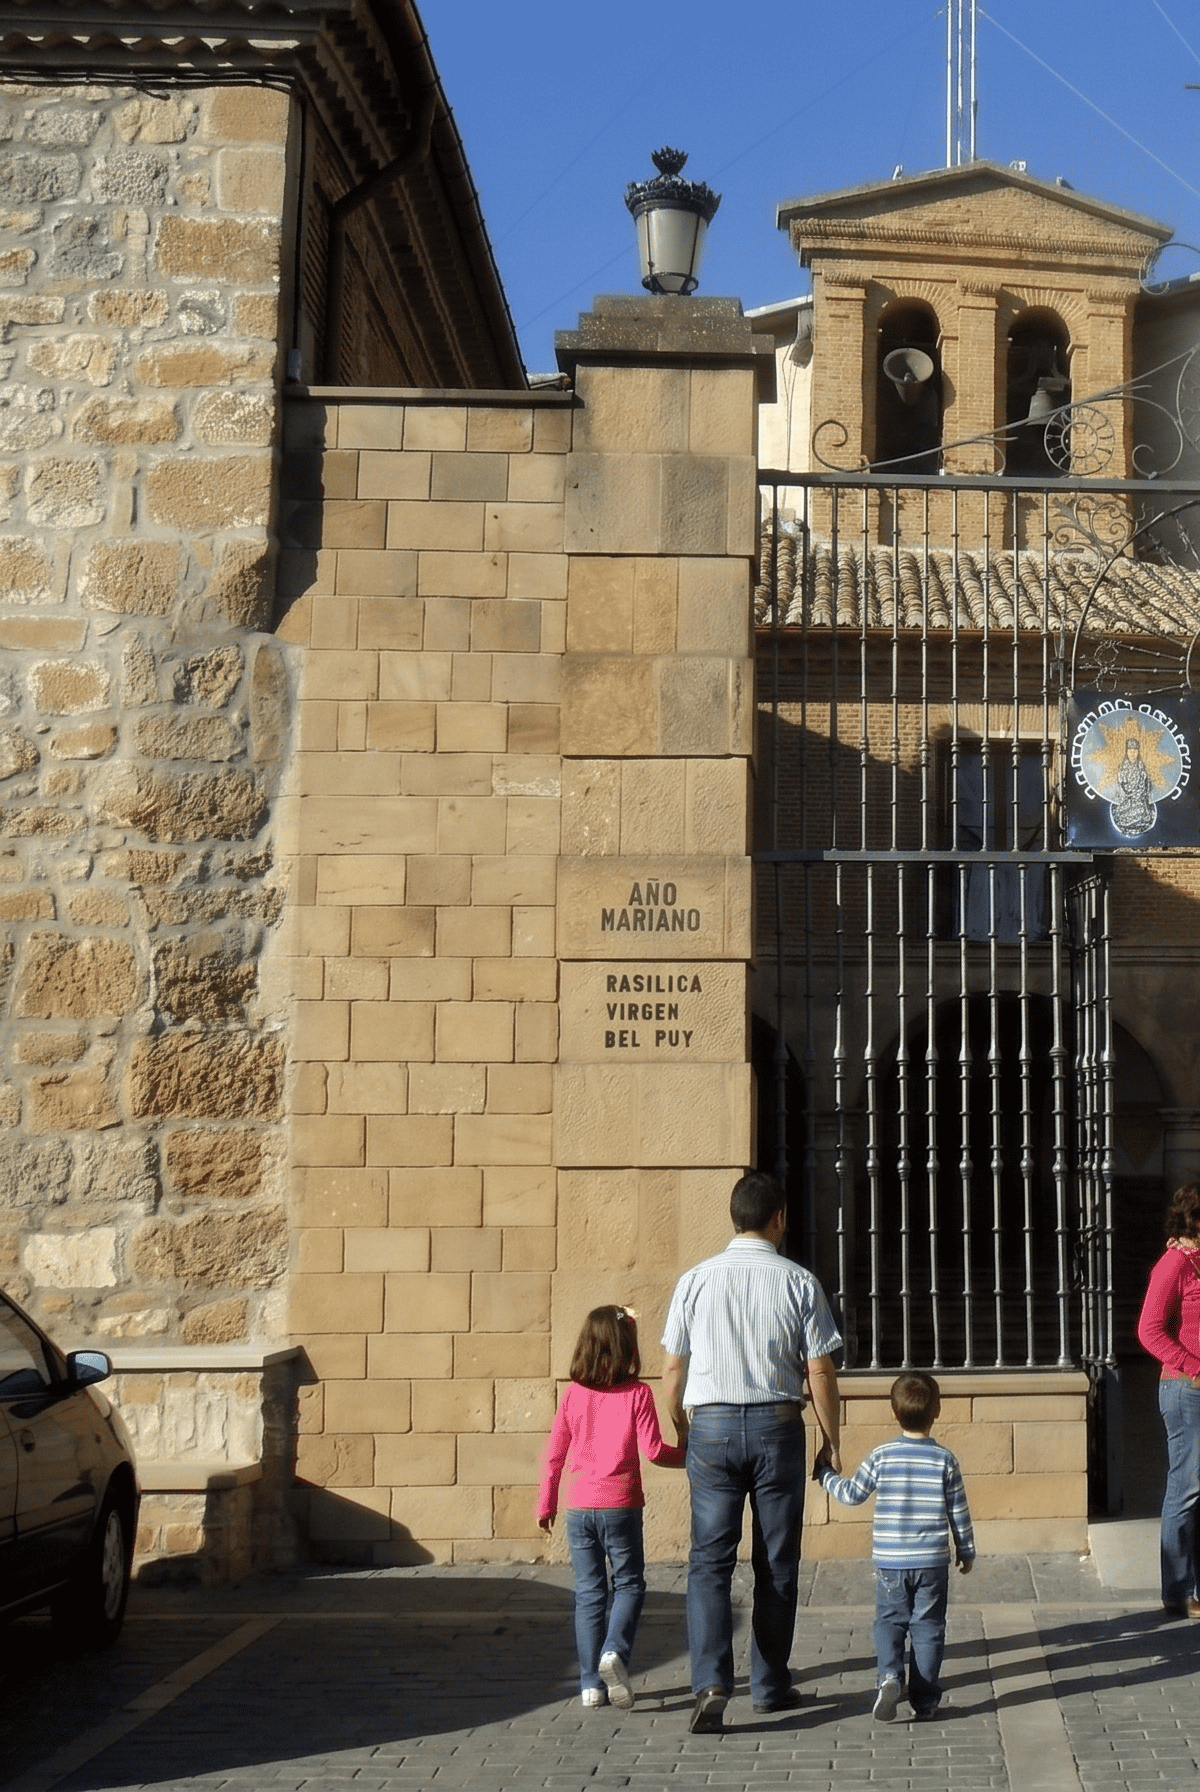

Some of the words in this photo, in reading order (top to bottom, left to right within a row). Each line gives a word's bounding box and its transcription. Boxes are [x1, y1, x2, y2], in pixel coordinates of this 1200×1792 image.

[628, 878, 677, 906] AÑO
[601, 908, 700, 932] MARIANO
[606, 1003, 678, 1021] VIRGEN
[655, 1030, 694, 1048] PUY
